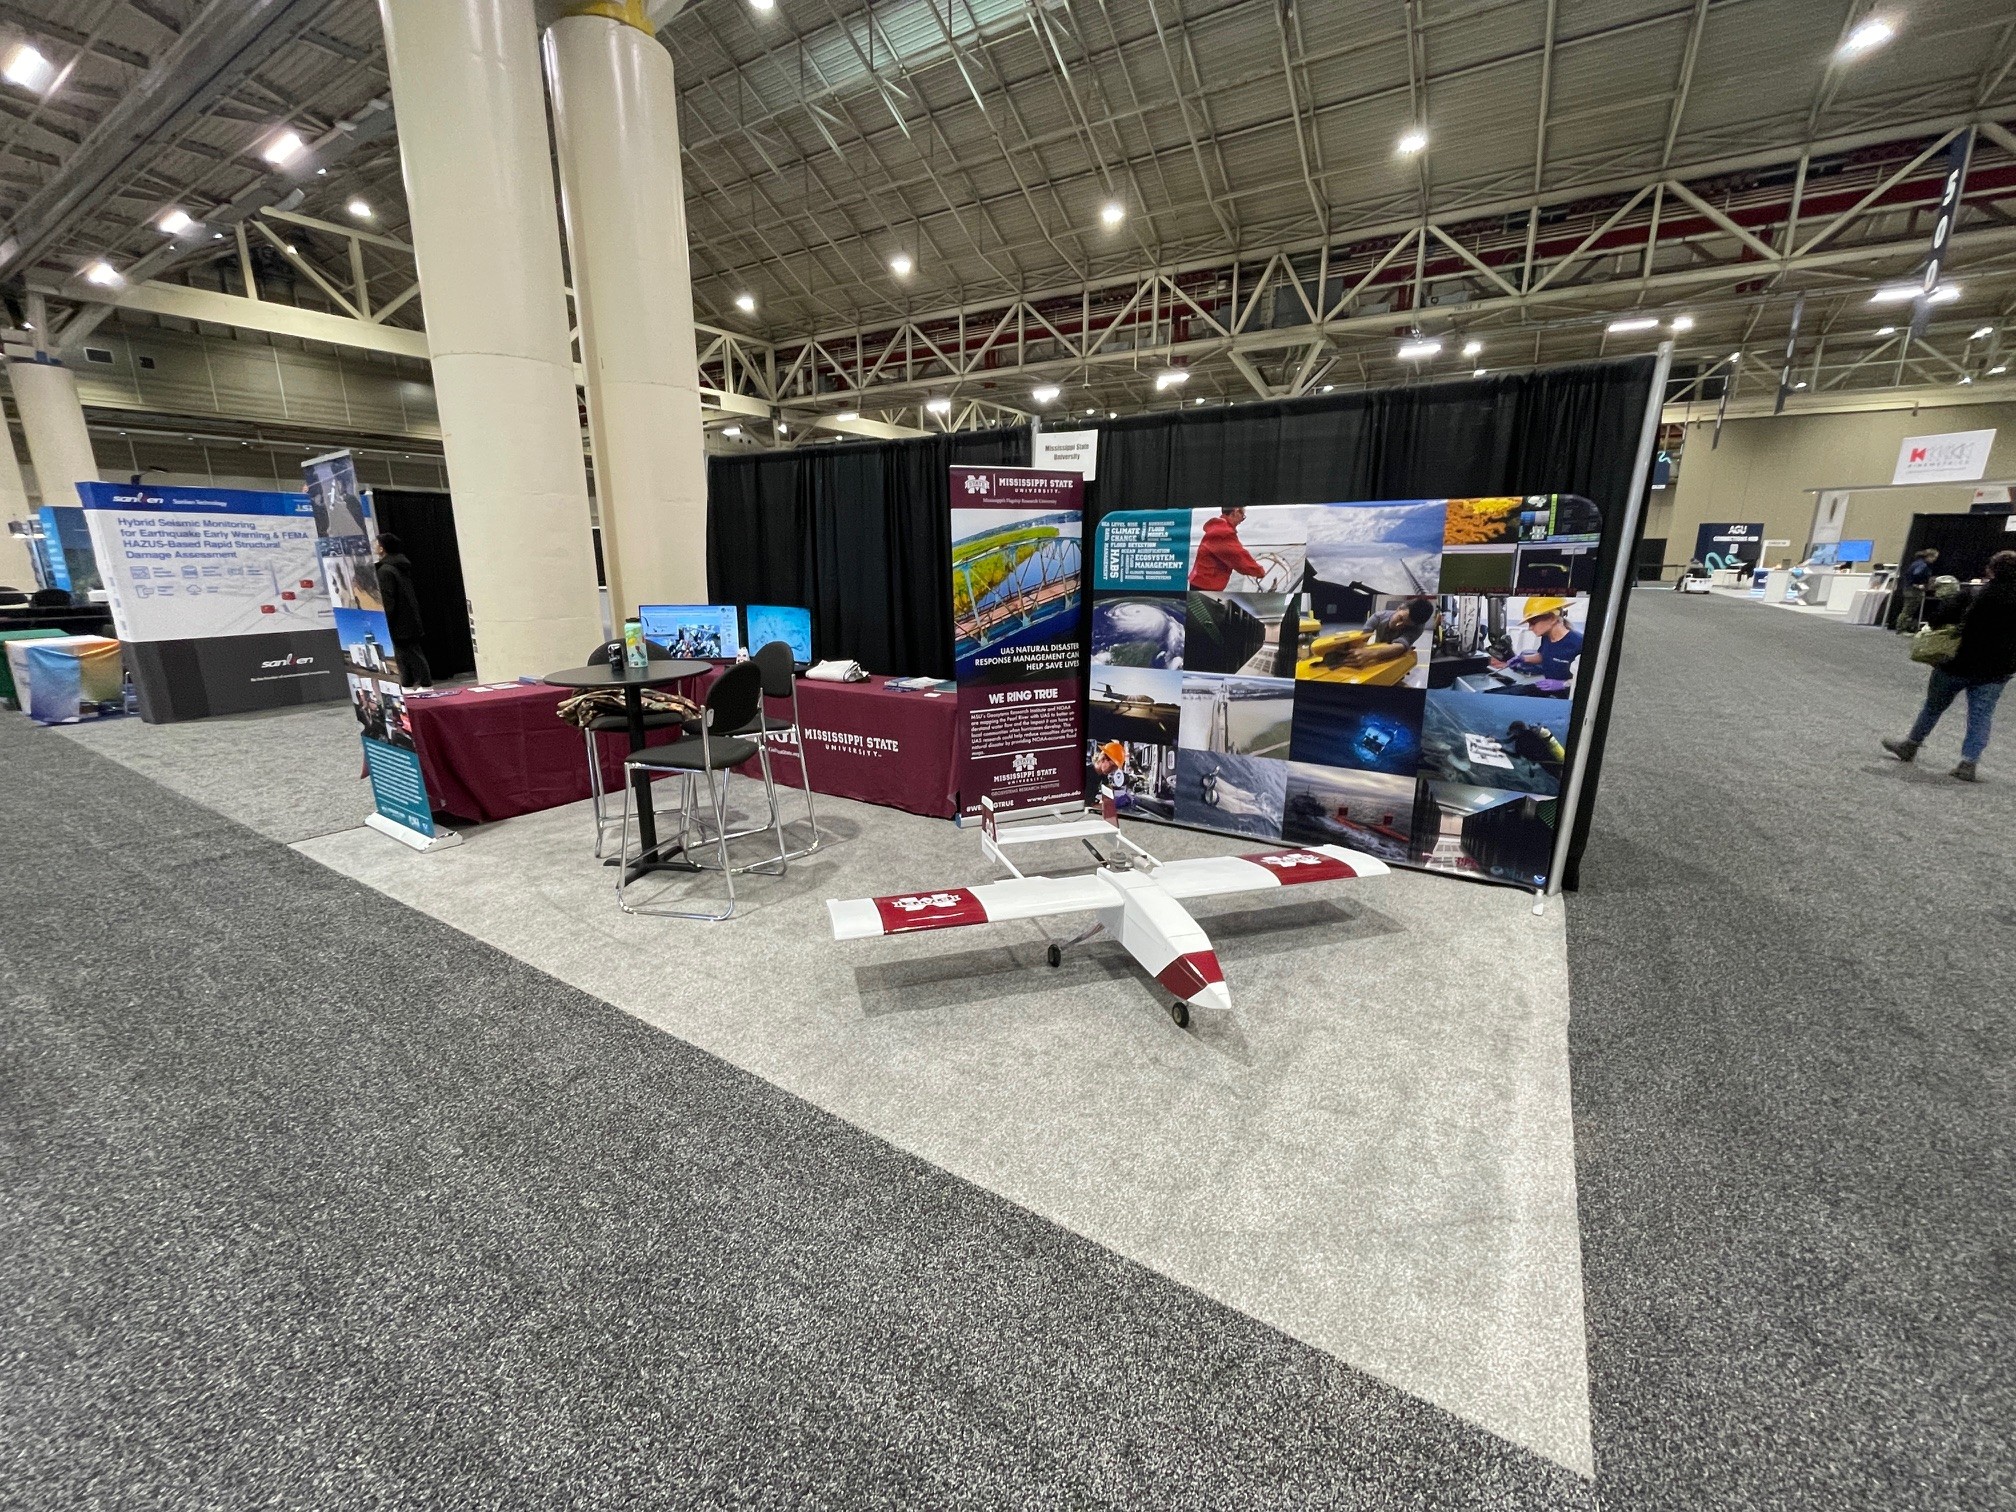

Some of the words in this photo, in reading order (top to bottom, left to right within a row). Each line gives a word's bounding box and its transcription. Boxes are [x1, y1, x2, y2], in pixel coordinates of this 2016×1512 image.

[1044, 444, 1076, 452] Mississippi
[1076, 443, 1090, 451] State
[1053, 453, 1081, 461] University
[998, 477, 1048, 488] MISSISSIPPI
[1050, 479, 1074, 488] STATE
[117, 517, 155, 527] Hybrid
[158, 519, 200, 528] Seismic
[202, 520, 256, 530] Monitoring
[1728, 525, 1748, 534] AGU
[121, 529, 136, 537] for
[140, 529, 201, 539] Earthquake
[203, 530, 229, 539] Early
[231, 531, 271, 540] Warning
[123, 540, 201, 548] HAZUS-Based
[204, 541, 233, 550] Rapid
[235, 541, 280, 549] Structural
[126, 551, 172, 560] Damage
[174, 551, 237, 559] Assessment
[1110, 549, 1120, 578] HABS
[1000, 647, 1015, 655] UAS
[1016, 645, 1049, 654] NATURAL
[1051, 642, 1079, 652] DISASTER
[975, 657, 1011, 666] RESPONSE
[1013, 653, 1065, 663] MANAGEMENT
[1067, 651, 1079, 659] CAN
[1026, 662, 1044, 671] HELP
[1045, 661, 1063, 670] SAVE
[1064, 659, 1079, 668] LIVES
[989, 694, 1005, 705] WE
[1007, 690, 1032, 702] RING
[1033, 688, 1058, 699] TRUE
[804, 728, 863, 747] MISSISSIPPI
[866, 737, 899, 752] STATE
[825, 744, 878, 757] UNIVERSITY
[993, 770, 1035, 782] MISSISSIPPI
[1037, 768, 1057, 776] STATE
